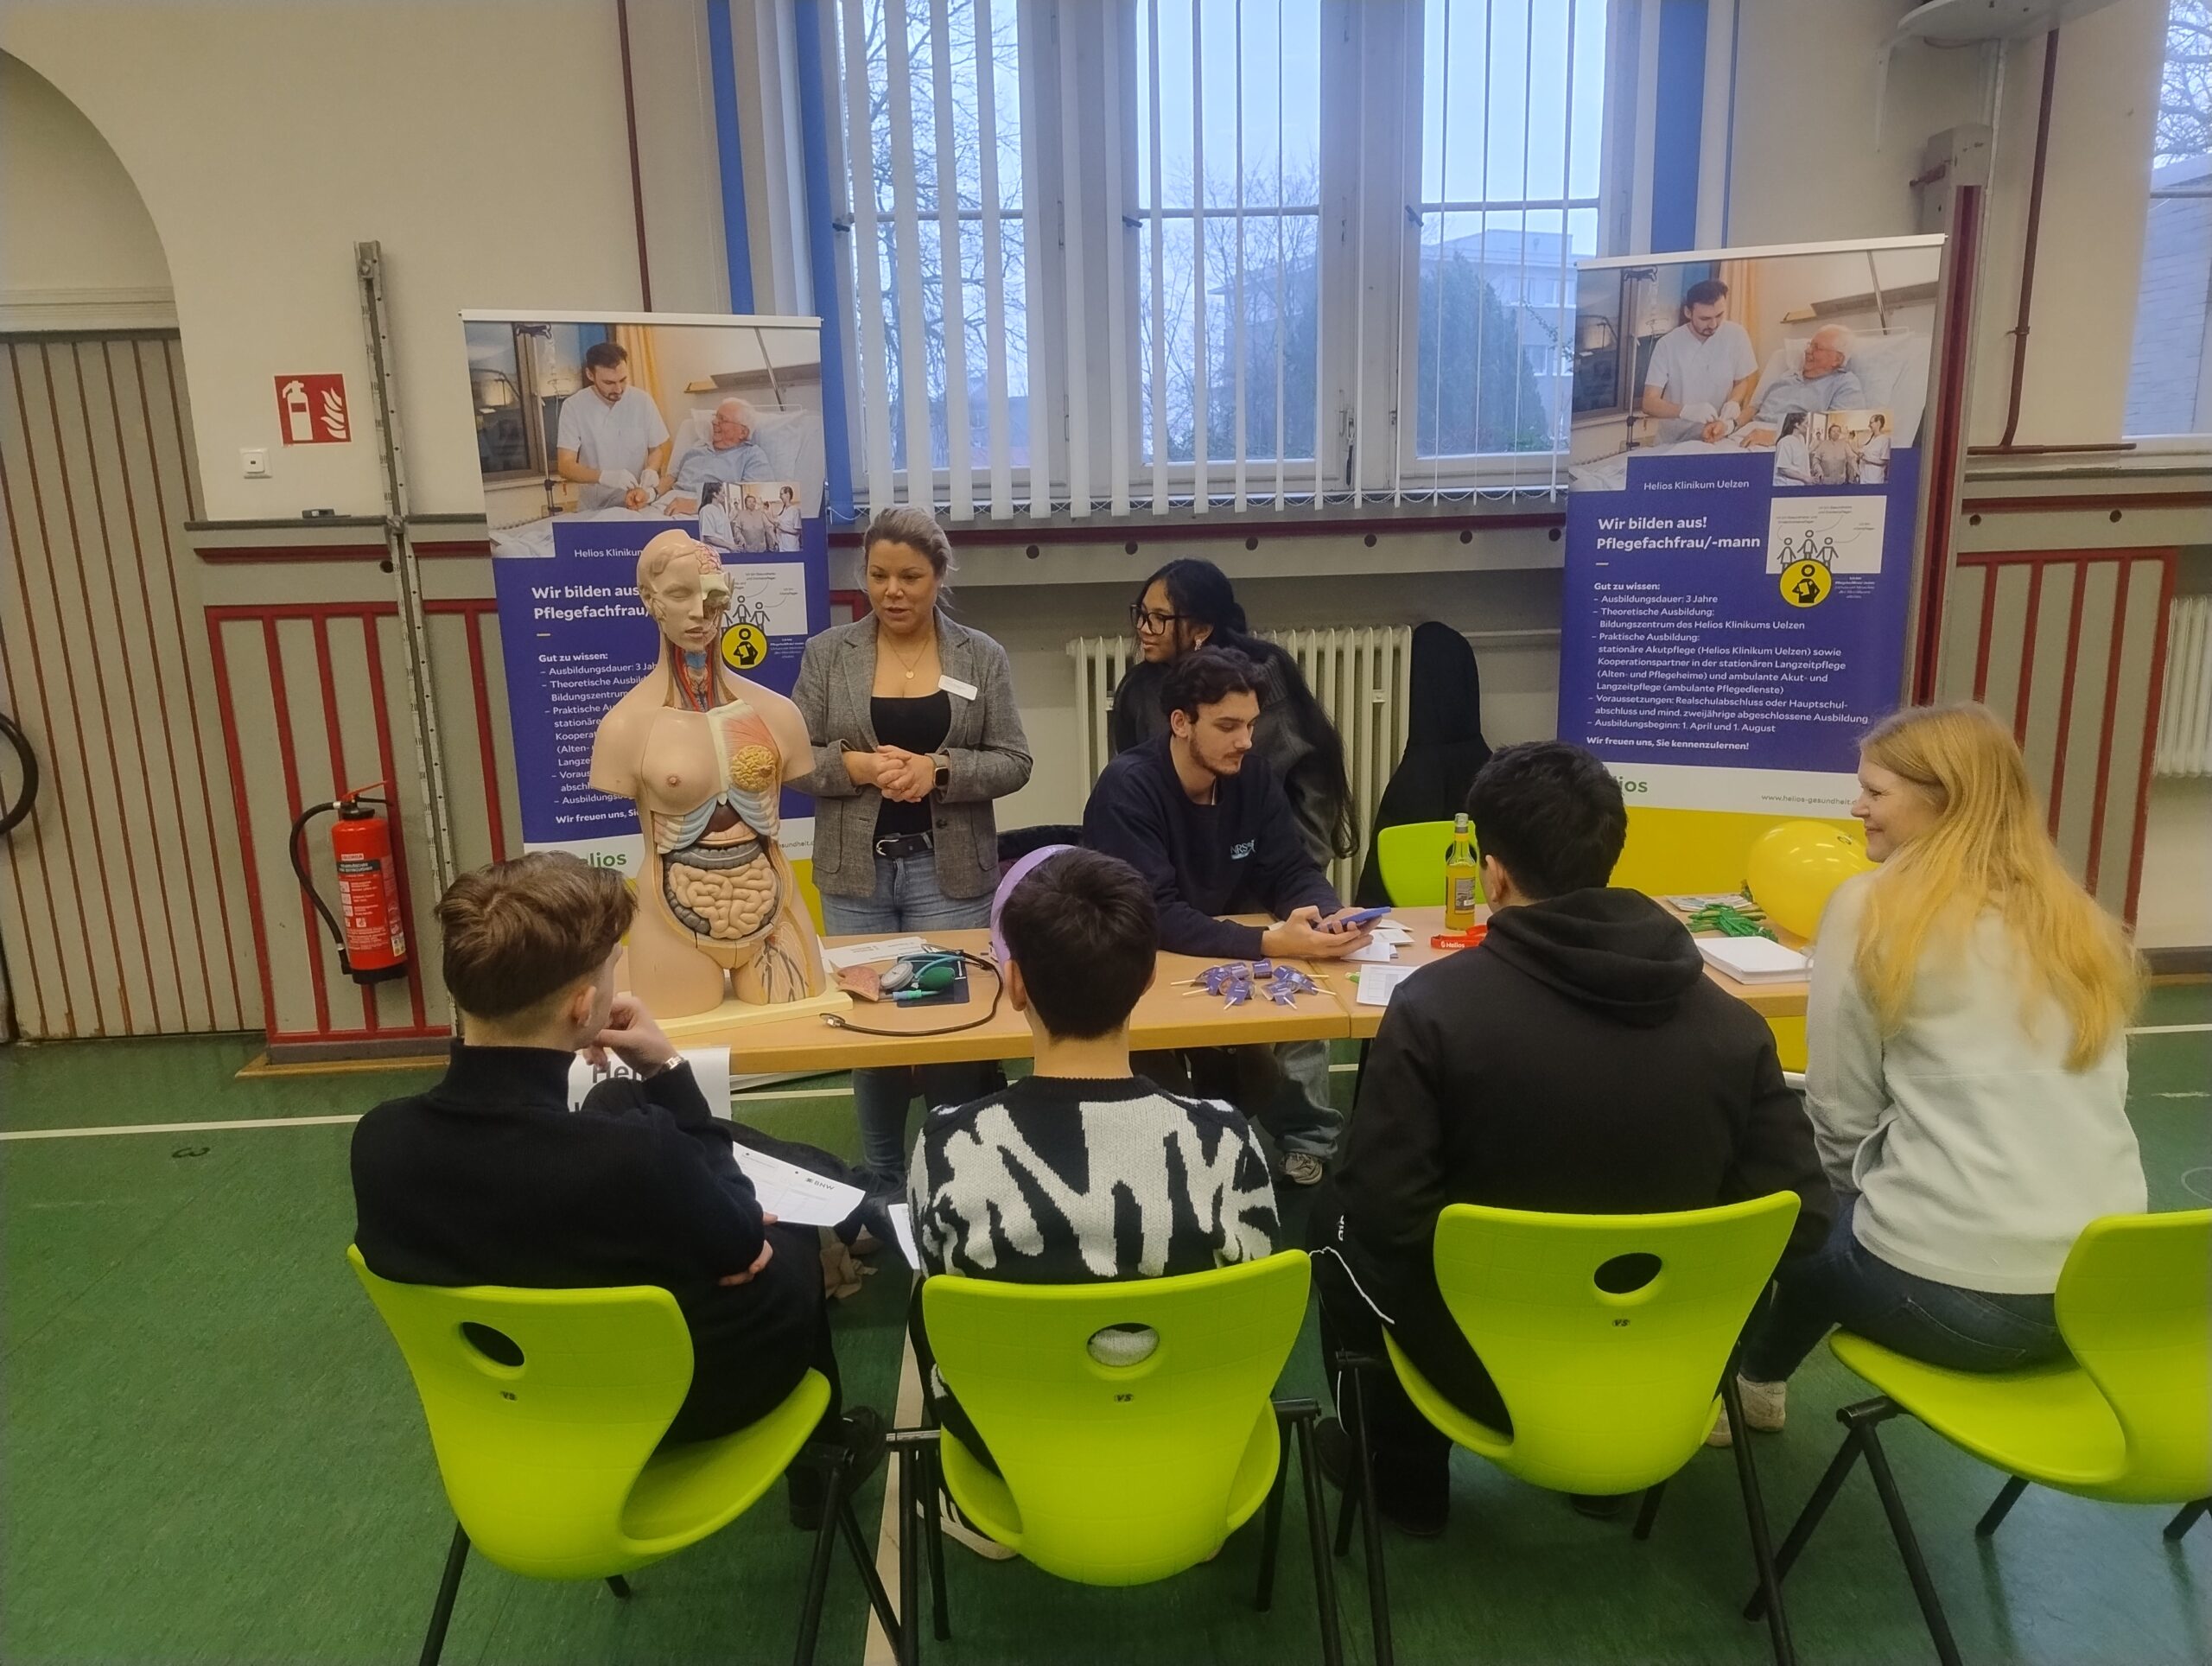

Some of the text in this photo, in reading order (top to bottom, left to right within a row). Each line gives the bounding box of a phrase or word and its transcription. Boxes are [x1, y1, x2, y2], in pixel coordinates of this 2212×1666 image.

[1644, 480, 1750, 491] Helios Klinikum Uelzen
[1599, 517, 1707, 530] Wir bilden aus!
[1597, 536, 1761, 551] Pflegefachfrau/-mann
[575, 549, 604, 558] Helios
[531, 586, 561, 599] Wir
[565, 586, 611, 598] bilden
[1601, 595, 1684, 604] Ausbildungsdauer:
[1661, 608, 1714, 617] Ausbildung:
[1600, 620, 1675, 629] Bildungszentrum
[1646, 633, 1700, 642] Ausbildung:
[1645, 646, 1695, 655] Akutpflege
[1698, 646, 1729, 655] (Helios
[573, 652, 608, 661] wissen:
[549, 664, 633, 676] Ausbildungsdauer:
[1599, 658, 1689, 667] Kooperationspartner
[1775, 660, 1846, 671] Langzeitpflege
[1649, 671, 1707, 680] Pflegeheime)
[1729, 672, 1778, 681] ambulante
[550, 677, 611, 688] Theoretische
[1597, 683, 1661, 692] Langzeitpflege
[1717, 685, 1783, 695] Pflegedienste)
[1597, 695, 1674, 704] Voraussetzungen:
[1675, 697, 1764, 707] Realschulabschluss
[1789, 700, 1847, 709] Hauptschul-
[553, 705, 601, 715] Praktische
[1595, 707, 1637, 715] abschluss
[1683, 709, 1735, 720] zweijährige
[1738, 711, 1811, 721] abgeschlossene
[1814, 714, 1868, 724] Ausbildung
[1595, 719, 1680, 729] Ausbildungsbeginn:
[1742, 724, 1776, 733] August
[1586, 736, 1603, 745] Wir
[1605, 737, 1634, 746] freuen
[1671, 739, 1749, 750] kennenzulernen!
[557, 746, 589, 754] (Alten-
[556, 815, 574, 824] Wir
[608, 811, 626, 819] uns,
